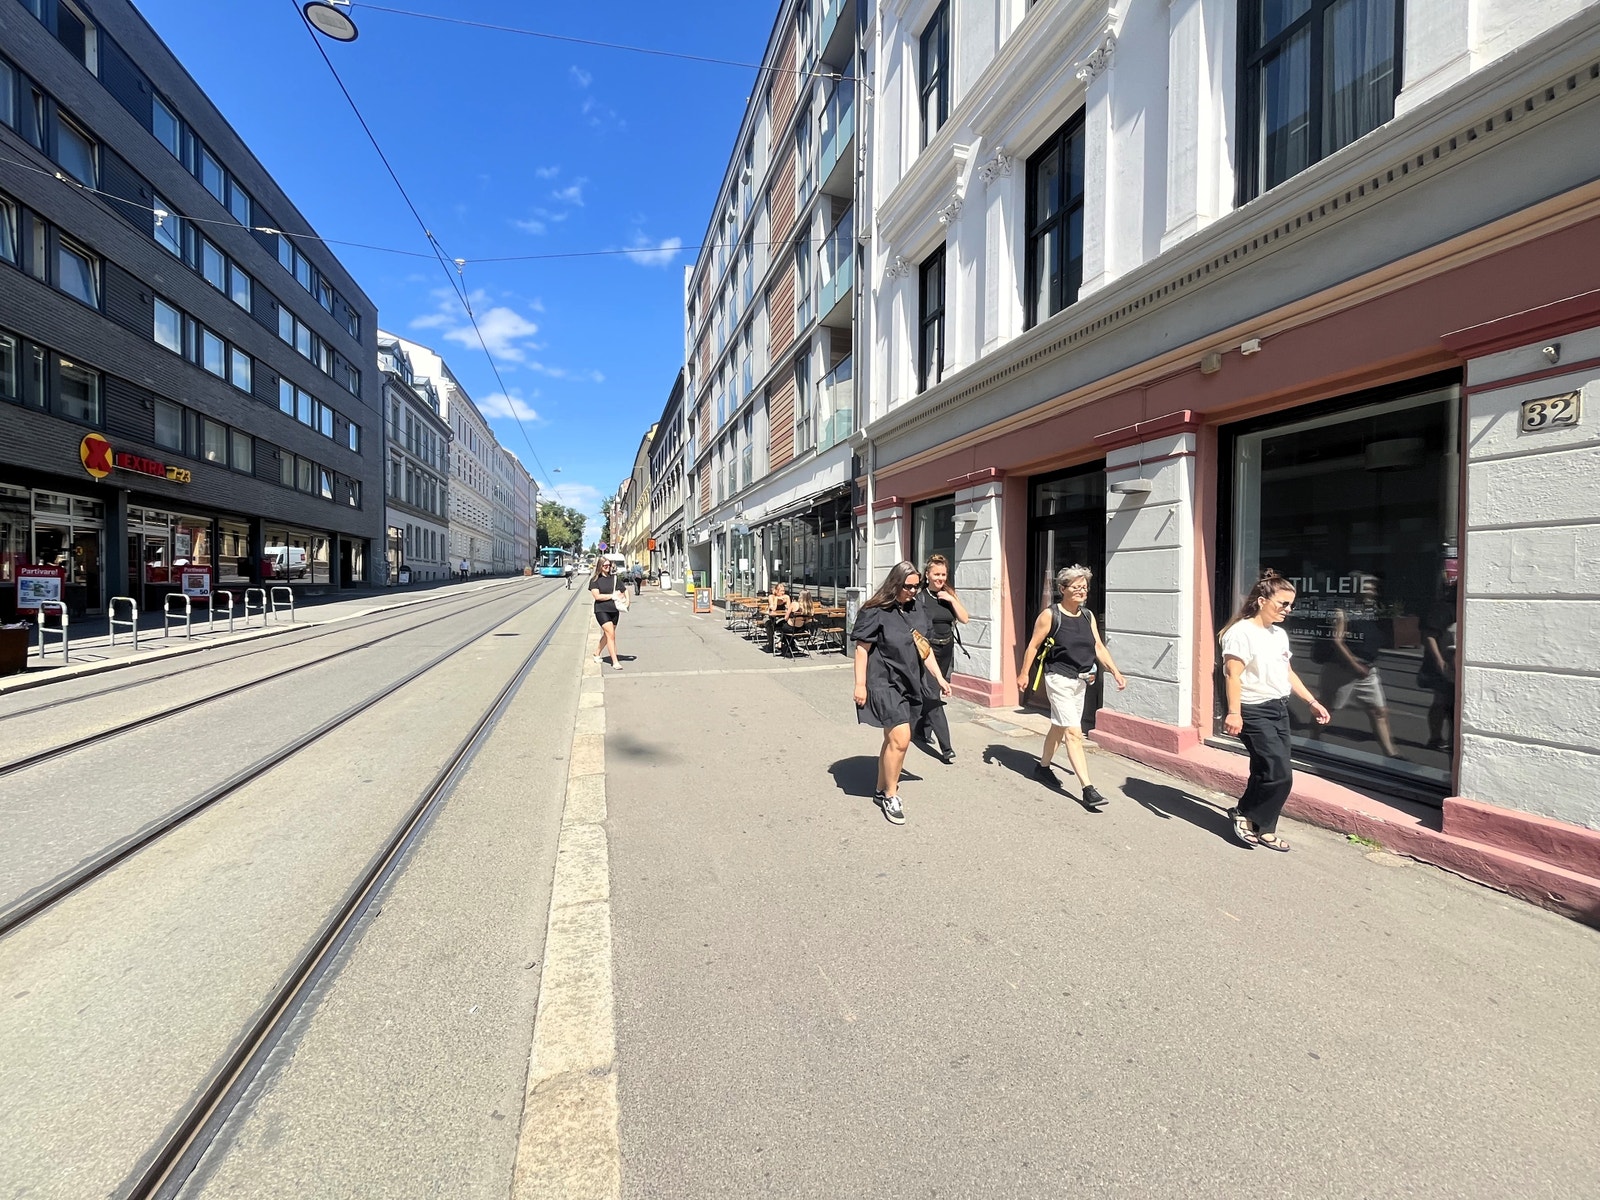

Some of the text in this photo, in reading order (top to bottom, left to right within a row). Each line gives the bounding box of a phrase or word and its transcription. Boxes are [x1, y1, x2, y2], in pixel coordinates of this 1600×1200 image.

[1527, 399, 1573, 427] 32
[121, 453, 191, 483] EXTRA 7-23
[21, 568, 58, 576] Partivare!
[1289, 577, 1373, 594] TIL LEIE
[1292, 629, 1364, 639] URBAN JUNGLE
